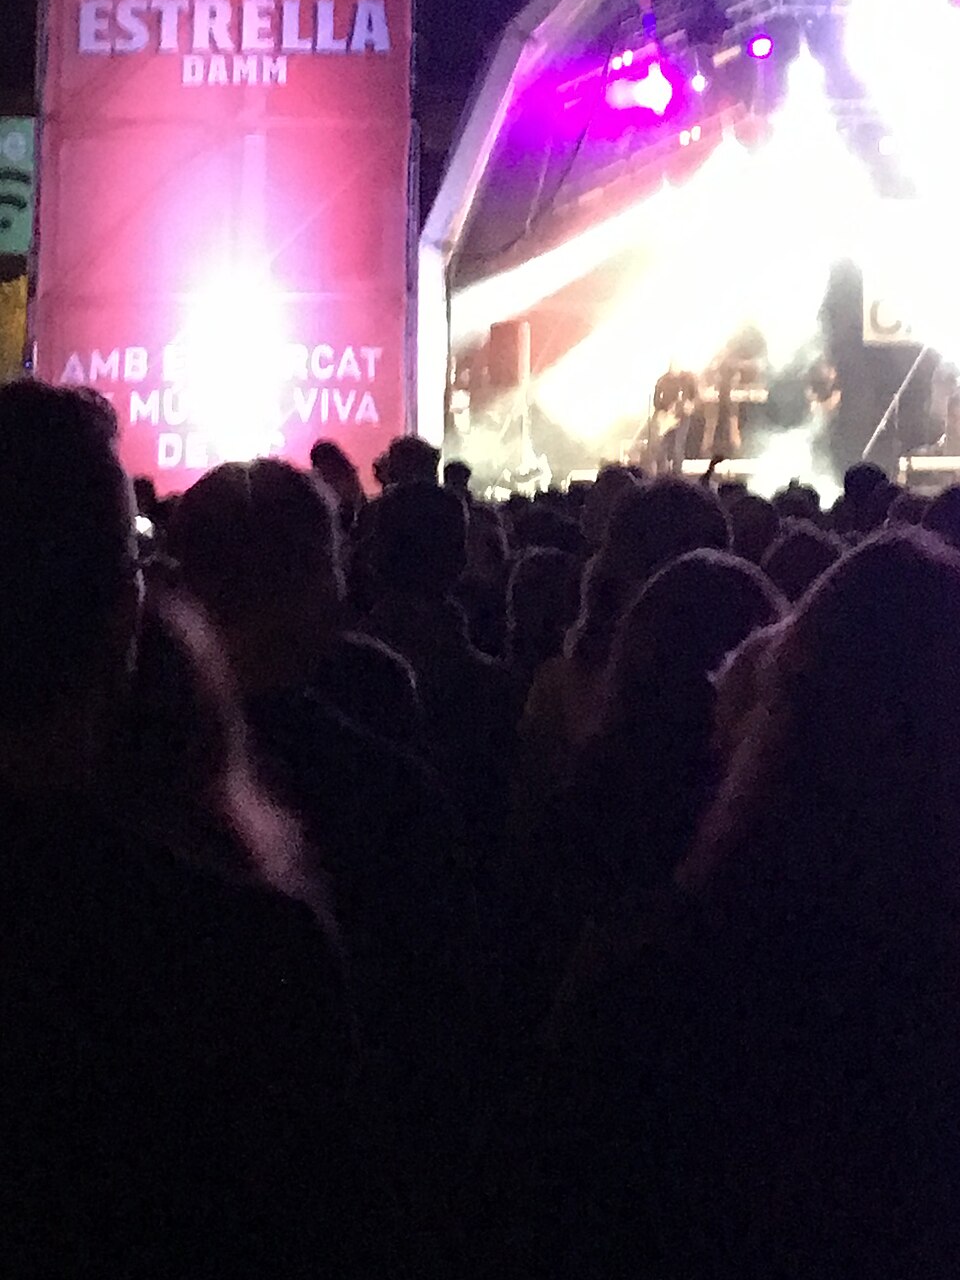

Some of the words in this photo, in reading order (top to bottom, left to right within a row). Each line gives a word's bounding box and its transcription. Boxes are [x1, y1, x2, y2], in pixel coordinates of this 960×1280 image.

[182, 54, 287, 86] DAMM
[59, 346, 149, 382] AMB
[293, 387, 380, 425] VIVA
[157, 432, 210, 469] DE
